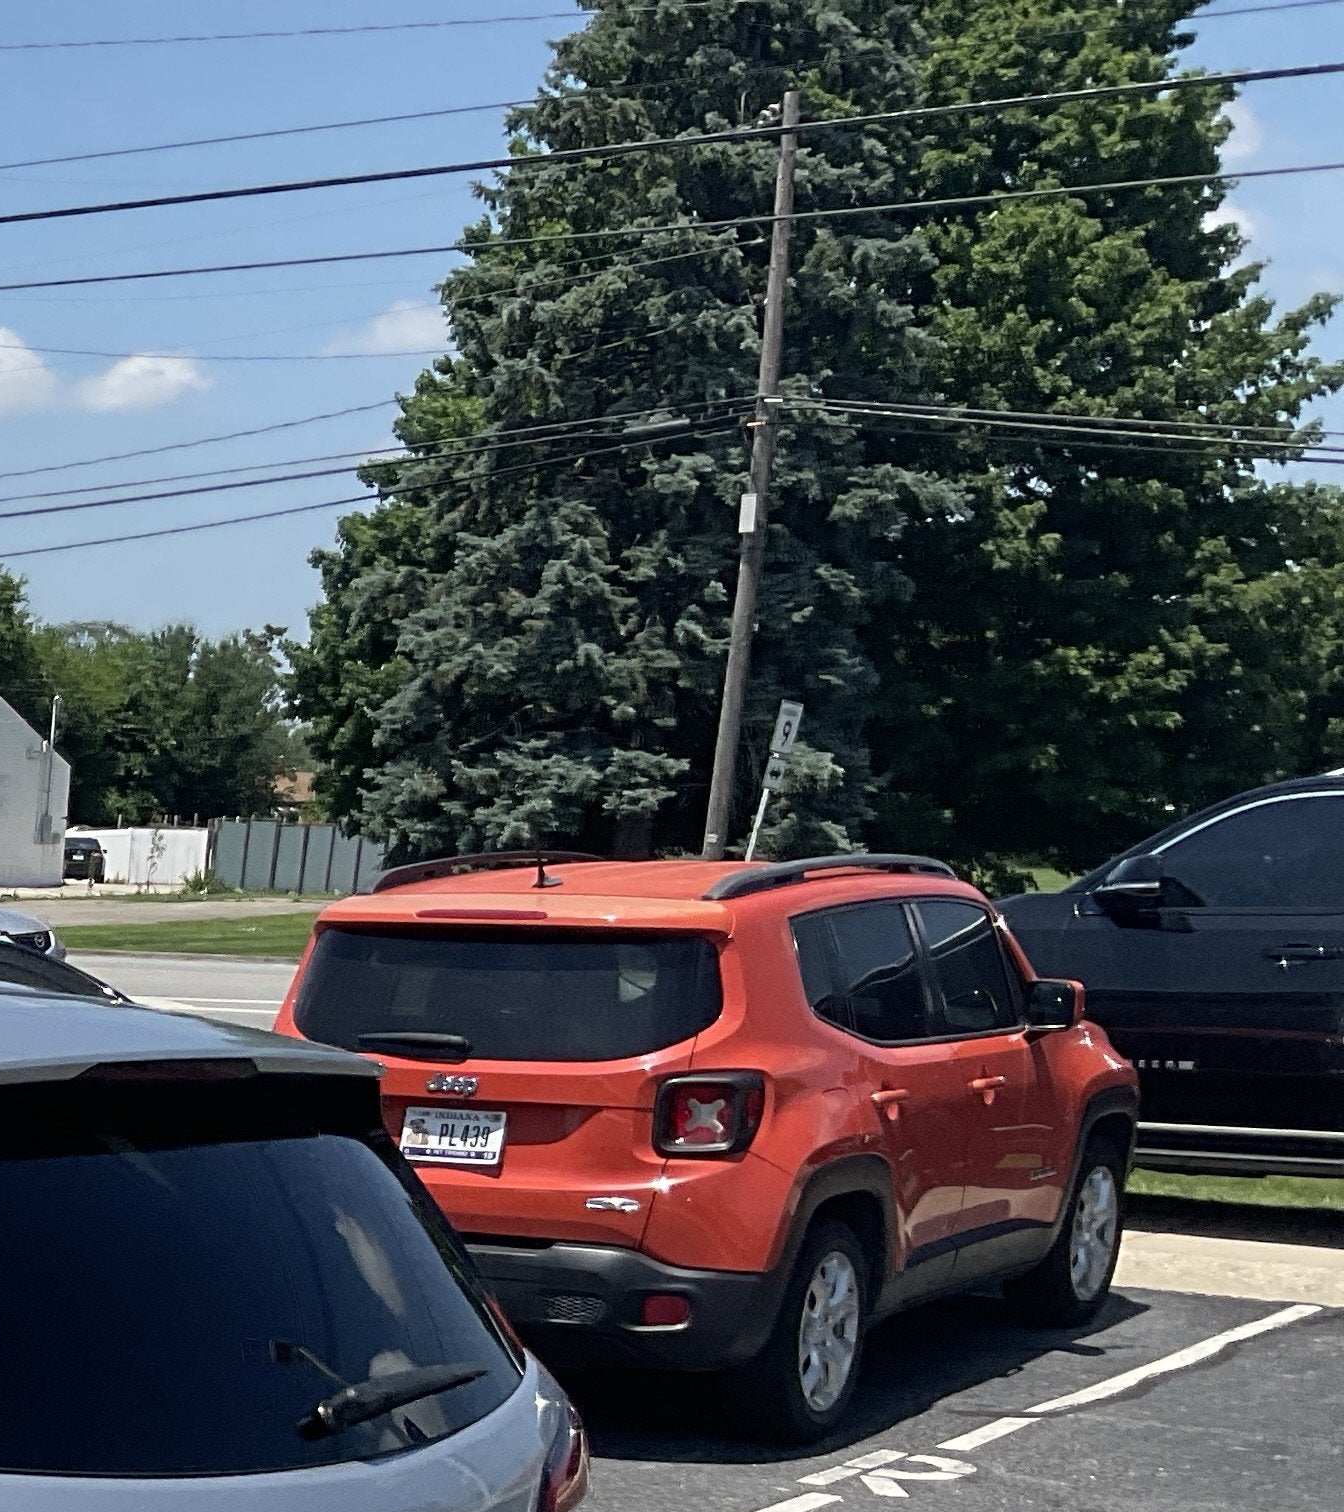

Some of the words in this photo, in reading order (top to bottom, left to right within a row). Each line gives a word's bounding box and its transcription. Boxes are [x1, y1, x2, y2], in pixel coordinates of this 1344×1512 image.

[426, 1073, 478, 1098] Jeep
[434, 1110, 481, 1121] INDIANA
[438, 1123, 491, 1148] PL439
